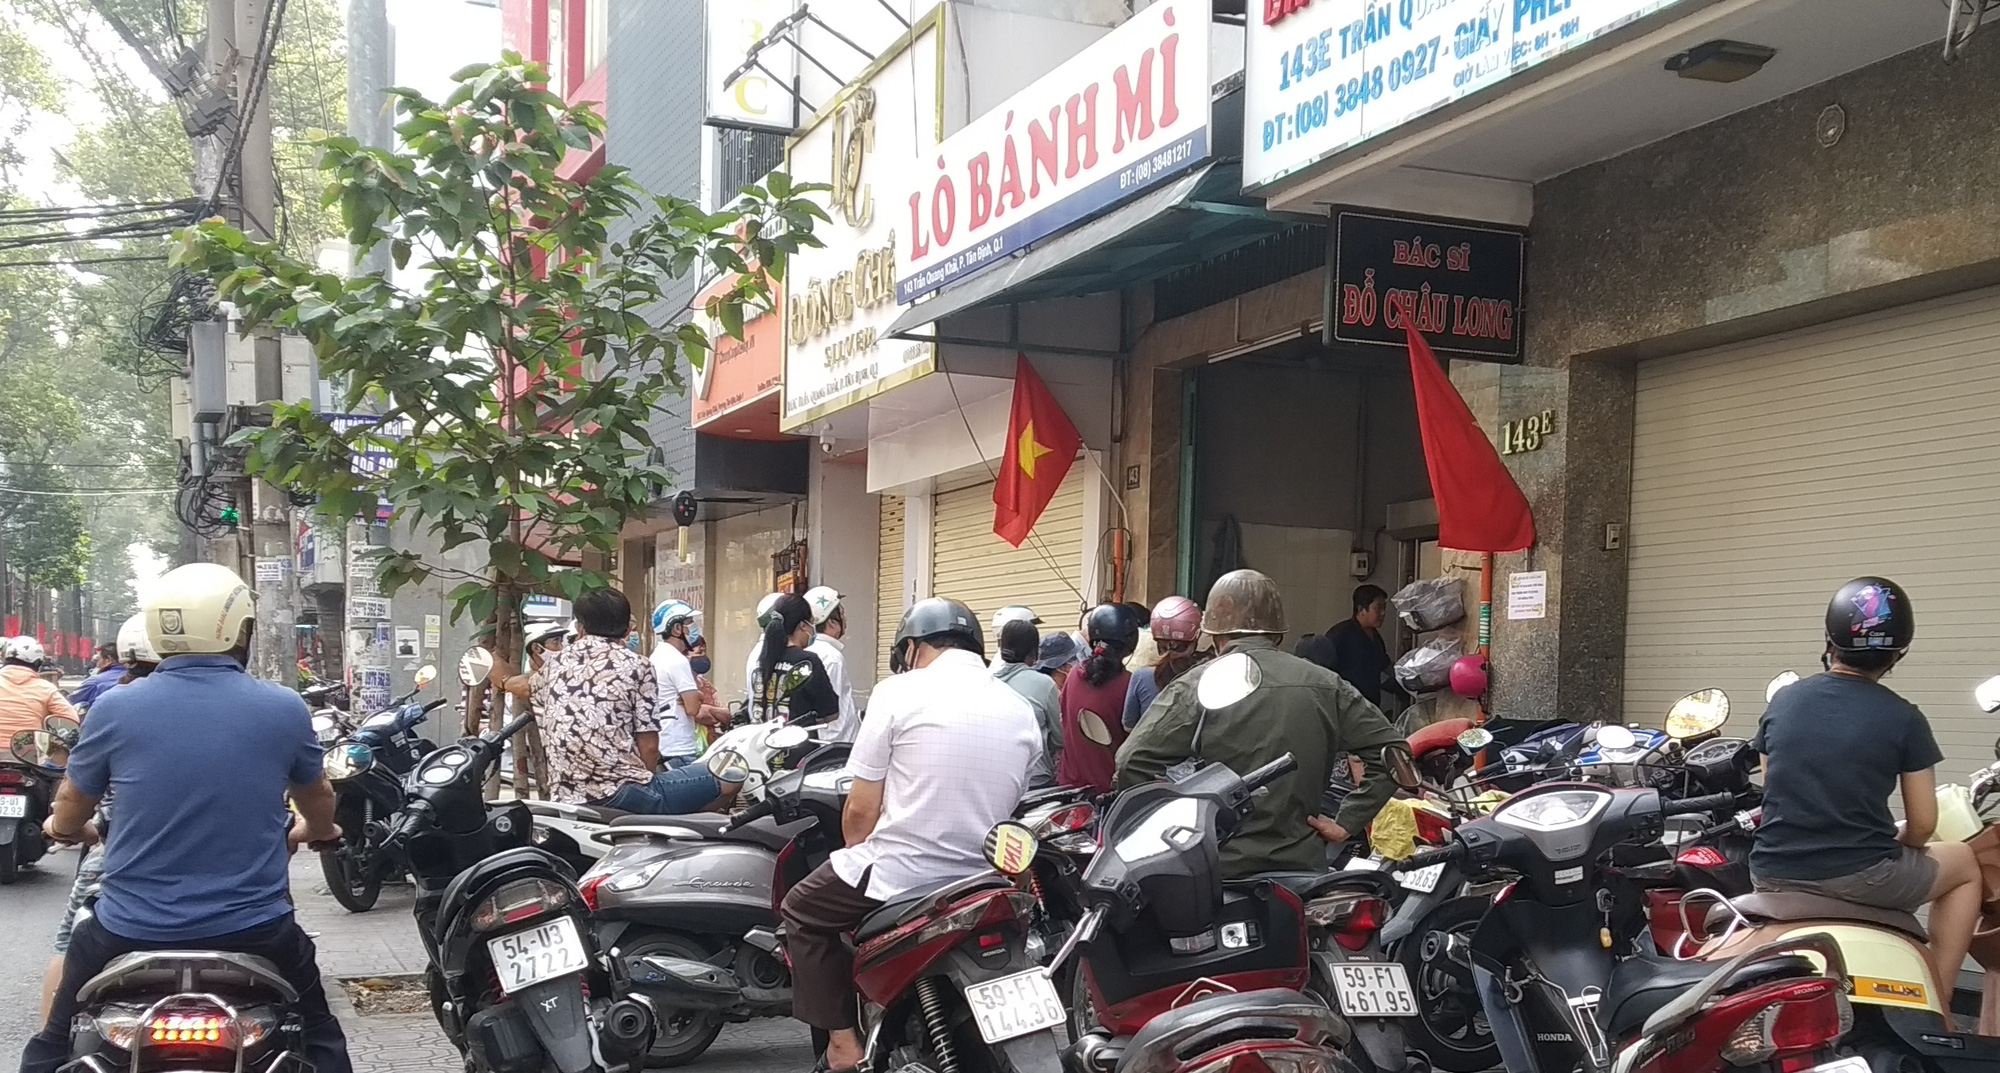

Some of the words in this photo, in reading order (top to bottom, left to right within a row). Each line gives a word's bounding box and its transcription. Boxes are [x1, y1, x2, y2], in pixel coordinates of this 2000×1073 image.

[1279, 28, 1332, 91] 143E
[1339, 1, 1391, 60] TRẦN
[1559, 16, 1580, 41] 18H
[1334, 65, 1383, 117] 3848
[1388, 36, 1441, 91] 0927
[1453, 1, 1504, 60] GIẤY
[908, 154, 956, 261] LÒ
[968, 82, 1099, 232] BÁNH
[1112, 6, 1179, 154] MÌ
[1152, 139, 1193, 173] 38481217
[1393, 236, 1440, 268] BÁC
[1446, 243, 1470, 271] SĨ
[904, 282, 912, 295] 143
[914, 271, 926, 290] Trần
[926, 268, 944, 285] Quang
[966, 250, 977, 266] Tân
[1343, 268, 1376, 327] ĐỖ
[1383, 281, 1449, 334] CHÂU
[1452, 296, 1514, 340] LONG
[1502, 409, 1555, 455] 143E
[684, 876, 755, 890] Grande
[501, 924, 564, 960] 54-U3
[510, 947, 574, 985] 2722
[1342, 967, 1396, 988] 59-F1
[540, 996, 559, 1012] XT
[978, 975, 1039, 1010] 59-F1
[1345, 991, 1411, 1012] 461.95
[1793, 985, 1826, 996] HONDA
[983, 998, 1059, 1038] 144.36
[1536, 1033, 1573, 1042] HONDA
